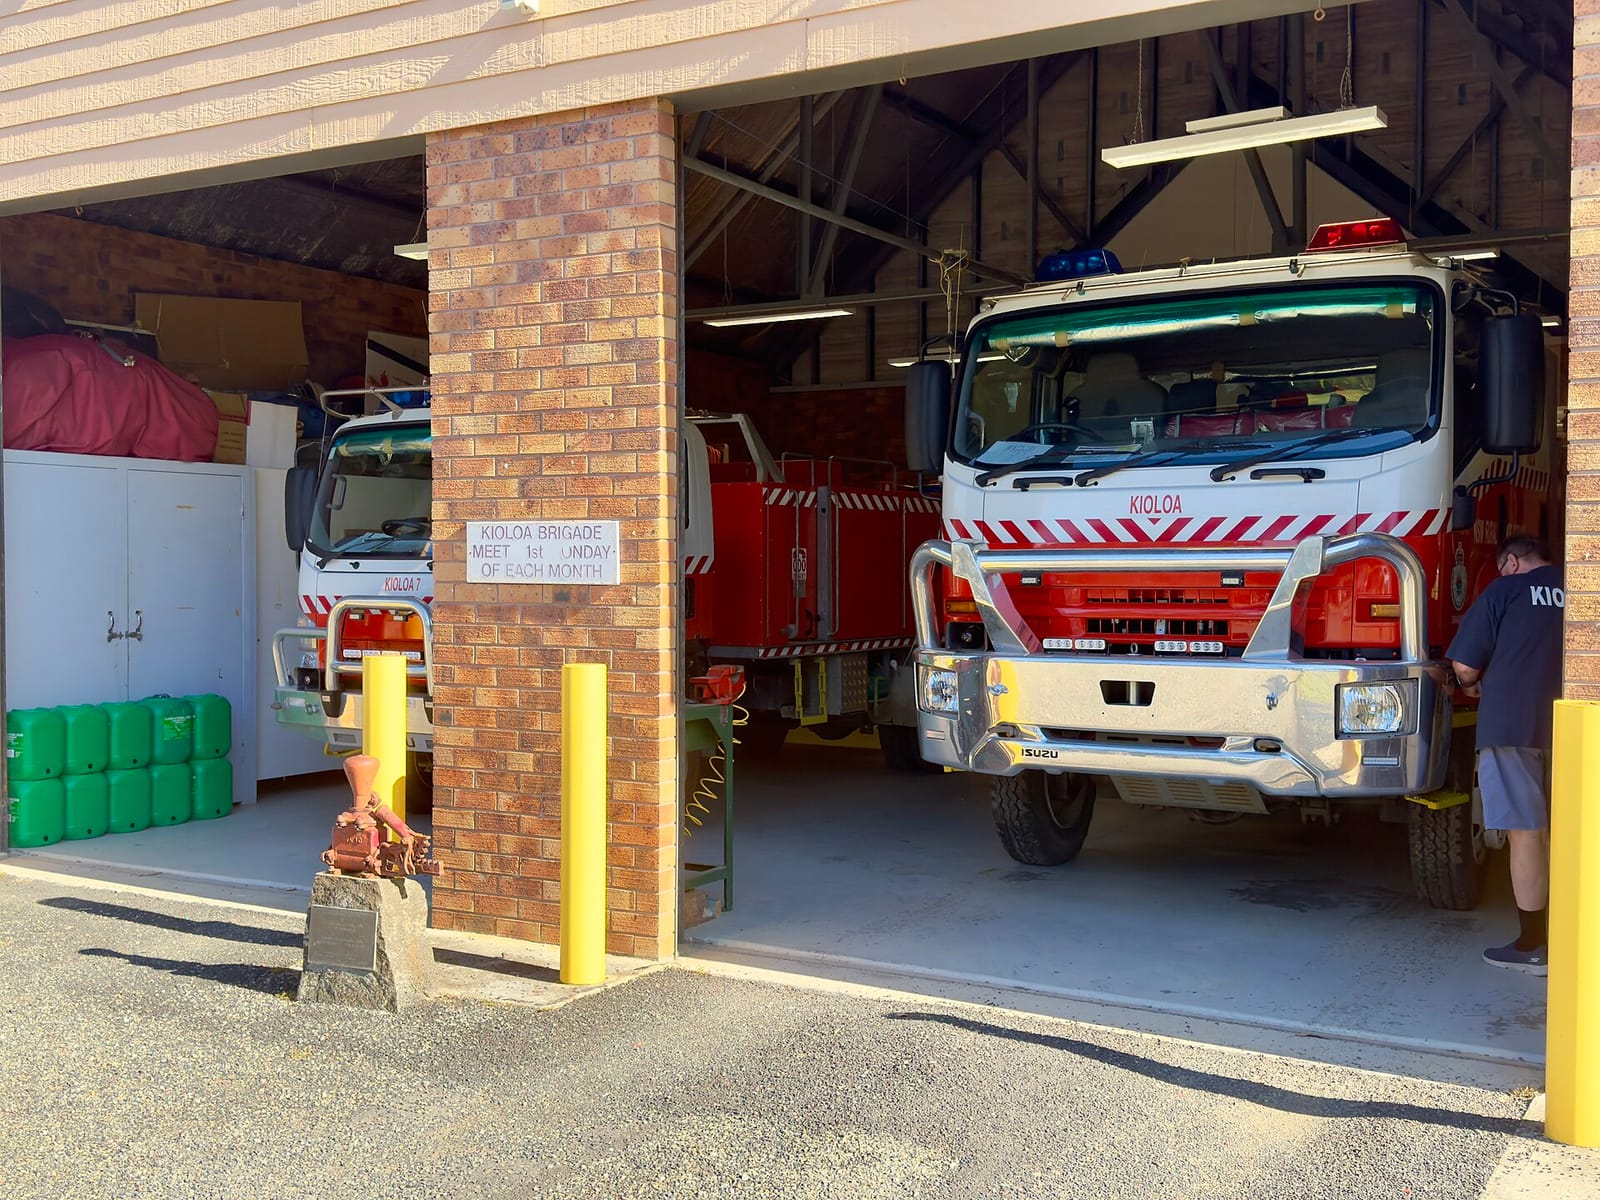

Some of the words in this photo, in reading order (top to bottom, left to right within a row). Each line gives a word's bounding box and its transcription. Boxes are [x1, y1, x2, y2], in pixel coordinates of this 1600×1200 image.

[1130, 494, 1182, 514] KIOLOA
[481, 525, 532, 540] KIOLOA
[538, 525, 602, 540] BRIGADE
[472, 544, 510, 559] MEET
[527, 544, 544, 559] 1st
[481, 563, 500, 577] OF
[505, 563, 544, 578] EACH
[549, 563, 602, 578] MONTH
[385, 577, 414, 591] KIOLOA
[416, 577, 421, 591] 7
[1021, 748, 1058, 758] ISUZU
